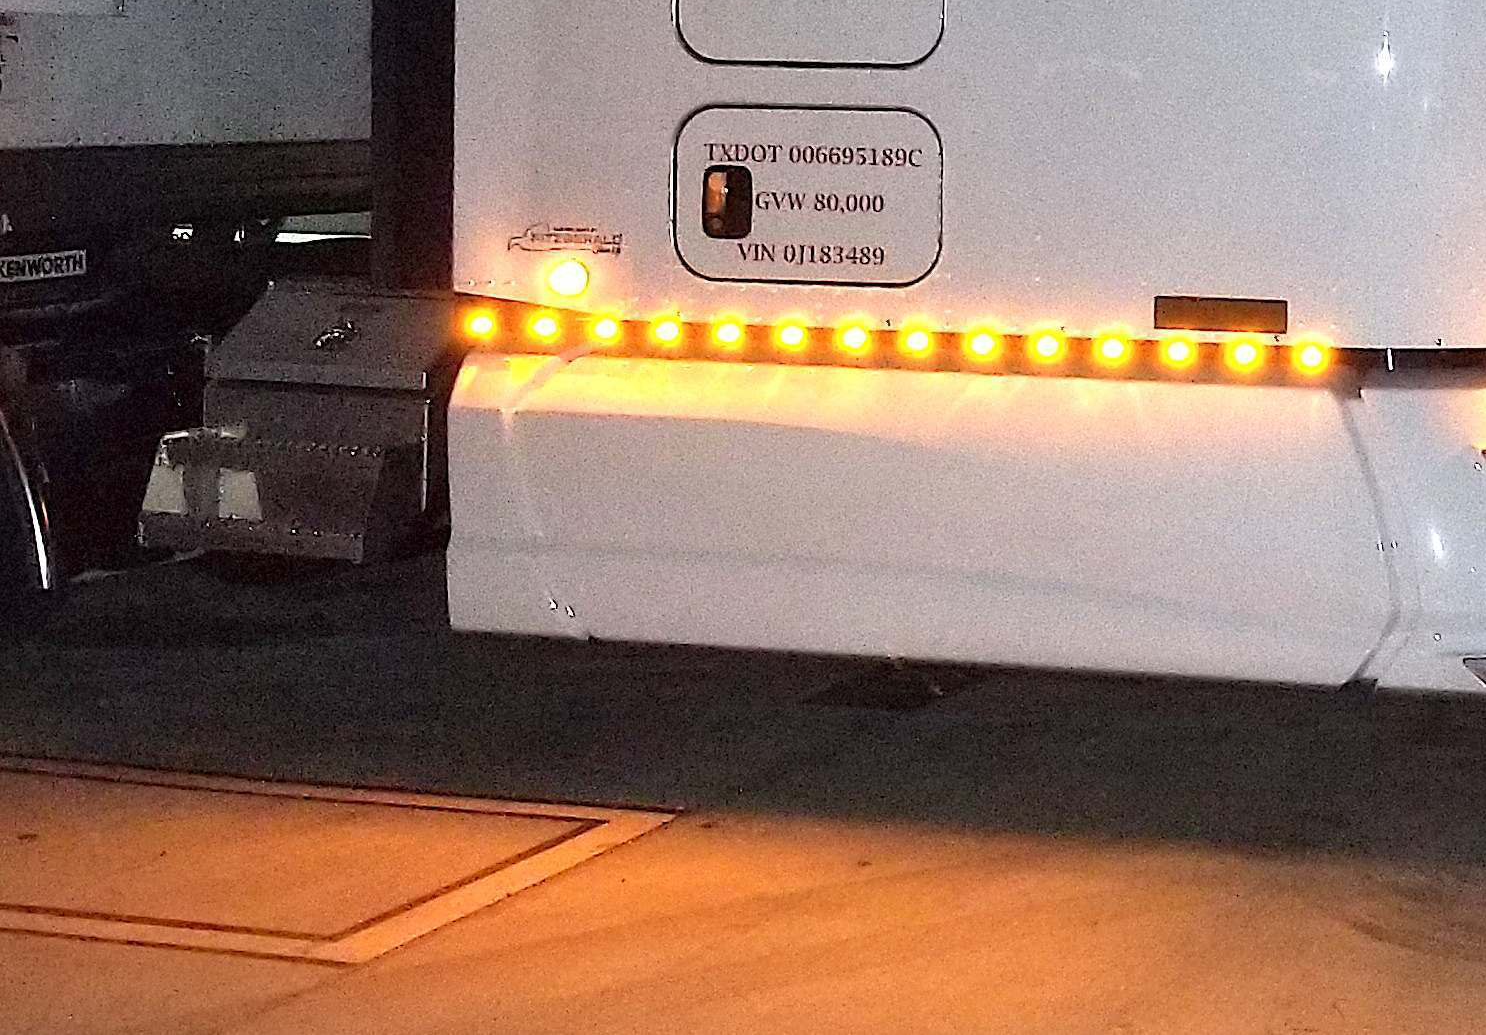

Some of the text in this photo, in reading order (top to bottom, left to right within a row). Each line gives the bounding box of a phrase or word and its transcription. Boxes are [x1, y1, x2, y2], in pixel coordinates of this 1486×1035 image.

[704, 143, 923, 166] TXDOT 006695189C
[755, 191, 885, 214] GVW 80,000
[737, 243, 775, 262] VIN
